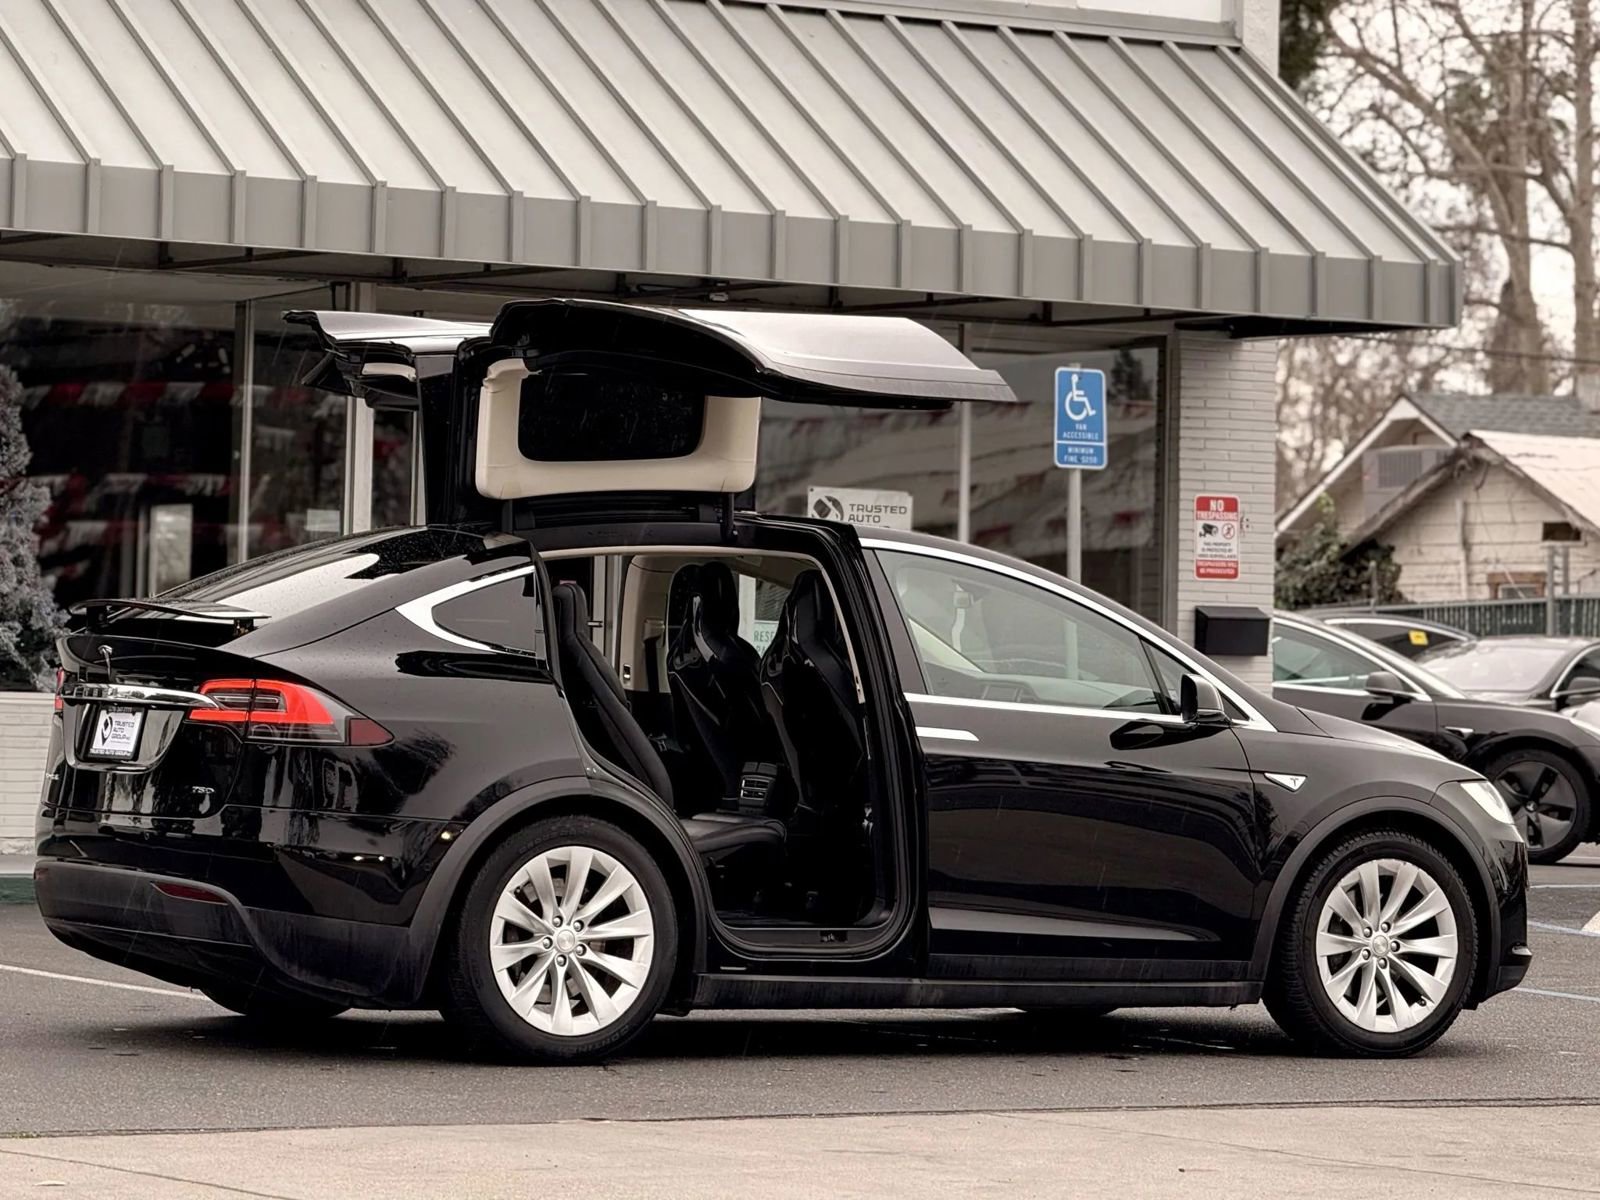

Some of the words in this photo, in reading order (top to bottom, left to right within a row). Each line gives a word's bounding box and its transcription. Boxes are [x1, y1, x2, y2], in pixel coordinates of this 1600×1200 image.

[1075, 423, 1087, 431] VAN
[1063, 431, 1099, 440] ACCESSIBLE
[1064, 455, 1078, 463] FINE
[849, 503, 907, 515] TRUSTED
[1210, 499, 1224, 512] NO
[848, 513, 881, 524] AUTO
[1197, 511, 1238, 521] TRESPASSING
[114, 720, 135, 728] TRUSTED
